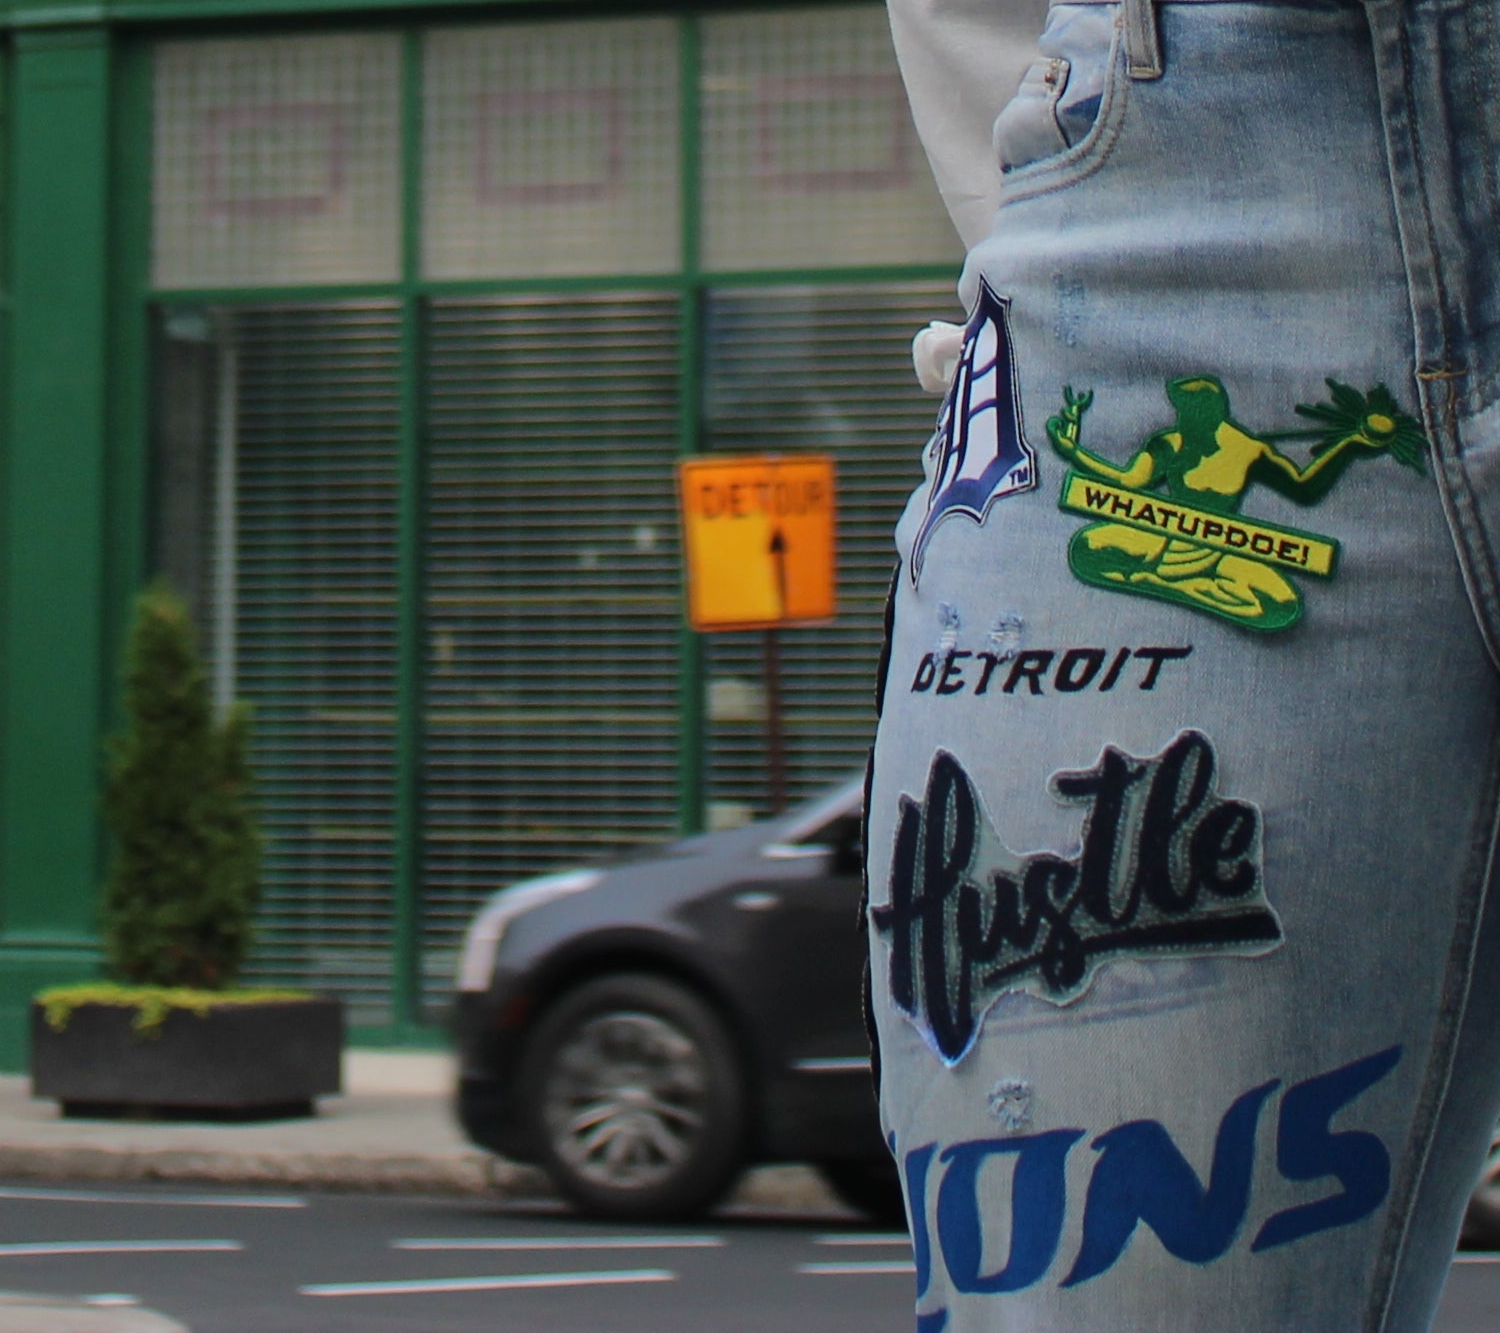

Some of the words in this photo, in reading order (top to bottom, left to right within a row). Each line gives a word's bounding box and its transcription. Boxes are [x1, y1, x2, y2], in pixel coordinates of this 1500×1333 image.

[1085, 486, 1310, 566] WHATUPDOE!
[911, 645, 1192, 694] DETROIT
[873, 730, 1282, 1060] Hustle
[890, 1044, 1402, 1333] IONS
